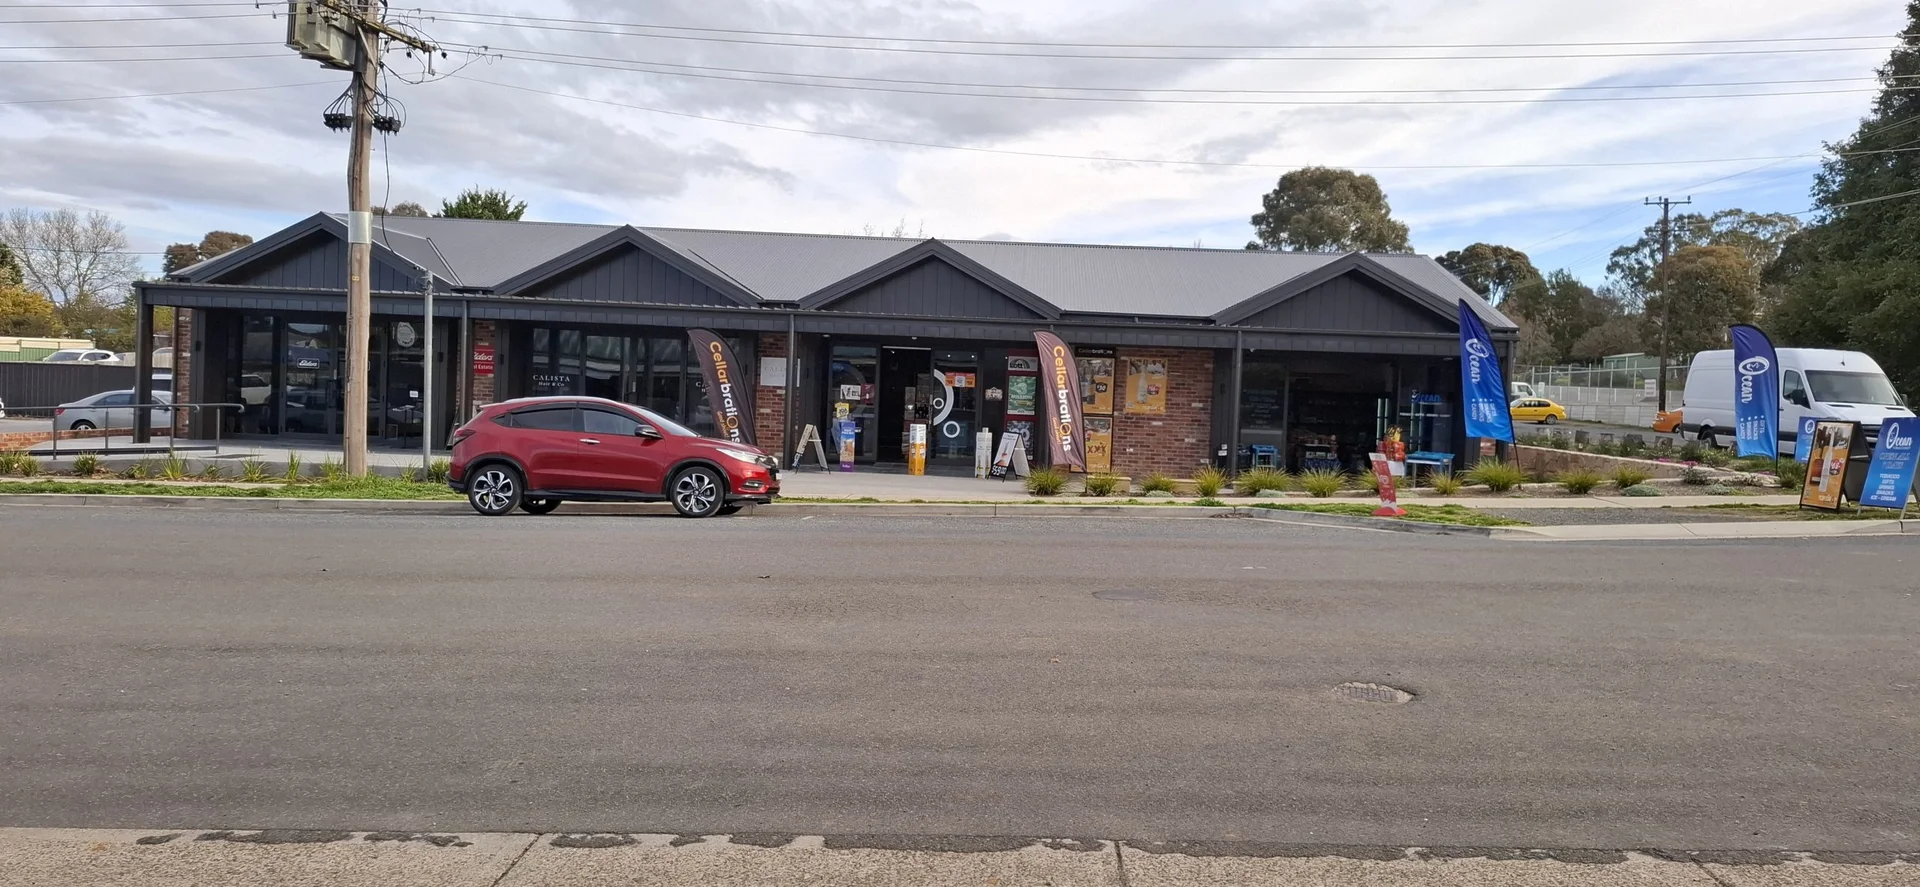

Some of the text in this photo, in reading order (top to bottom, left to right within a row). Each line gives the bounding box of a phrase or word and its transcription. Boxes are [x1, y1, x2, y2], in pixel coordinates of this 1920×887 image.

[474, 352, 494, 361] lders
[1465, 338, 1490, 385] Ocean
[532, 374, 570, 382] CALISTA
[1738, 356, 1770, 404] Ocean
[1886, 422, 1913, 449] Ocean
